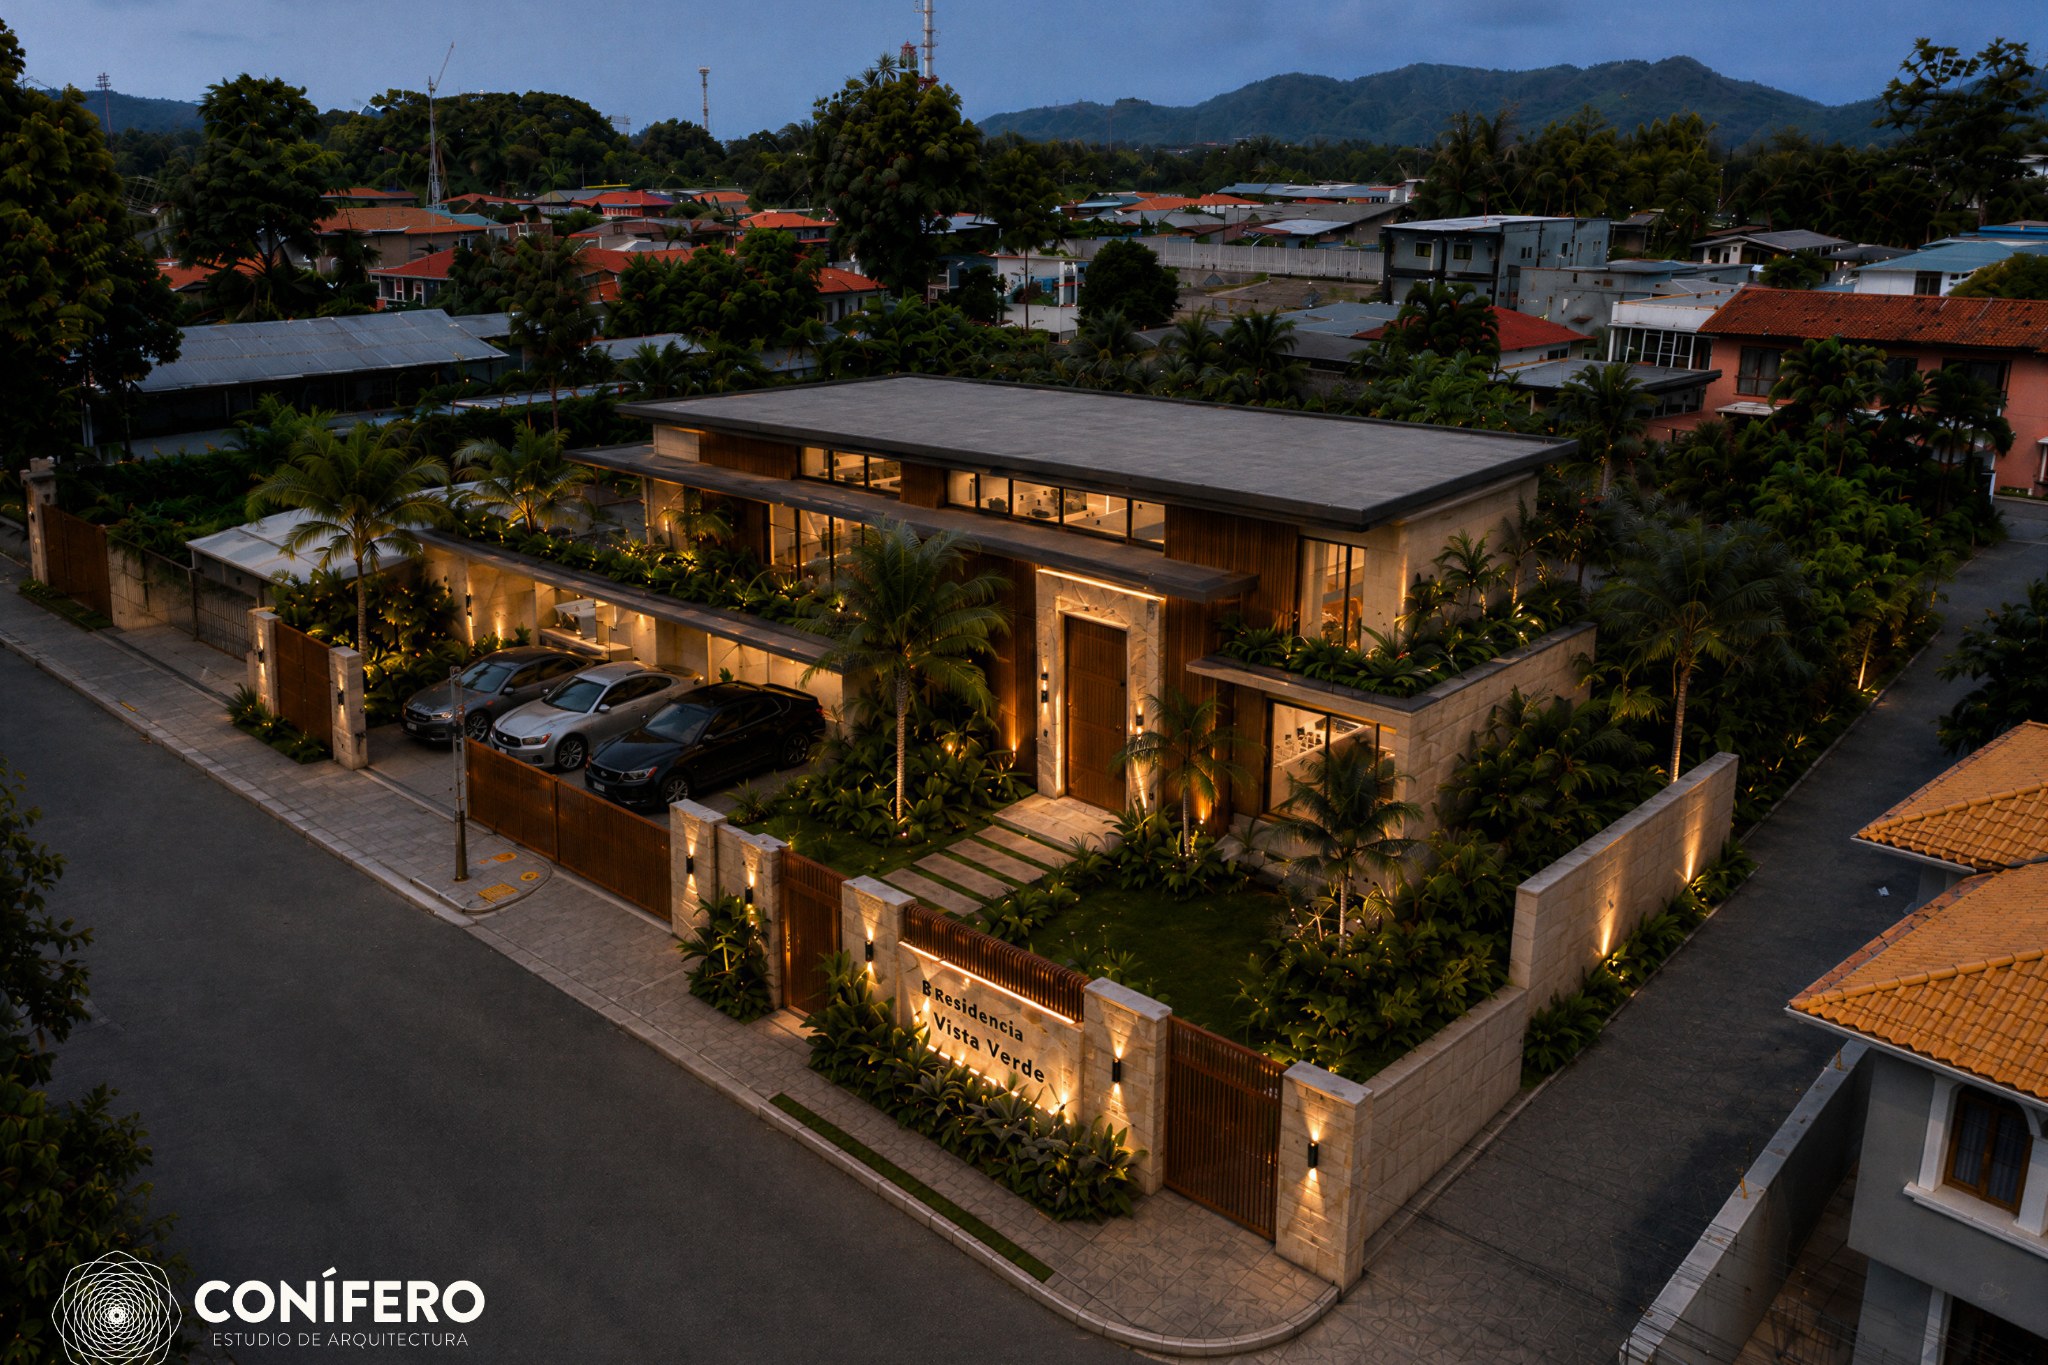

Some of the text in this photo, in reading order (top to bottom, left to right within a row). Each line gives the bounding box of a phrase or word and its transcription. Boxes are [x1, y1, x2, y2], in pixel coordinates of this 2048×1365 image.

[935, 987, 1024, 1042] Residencia
[933, 1012, 1045, 1083] Vista Verde
